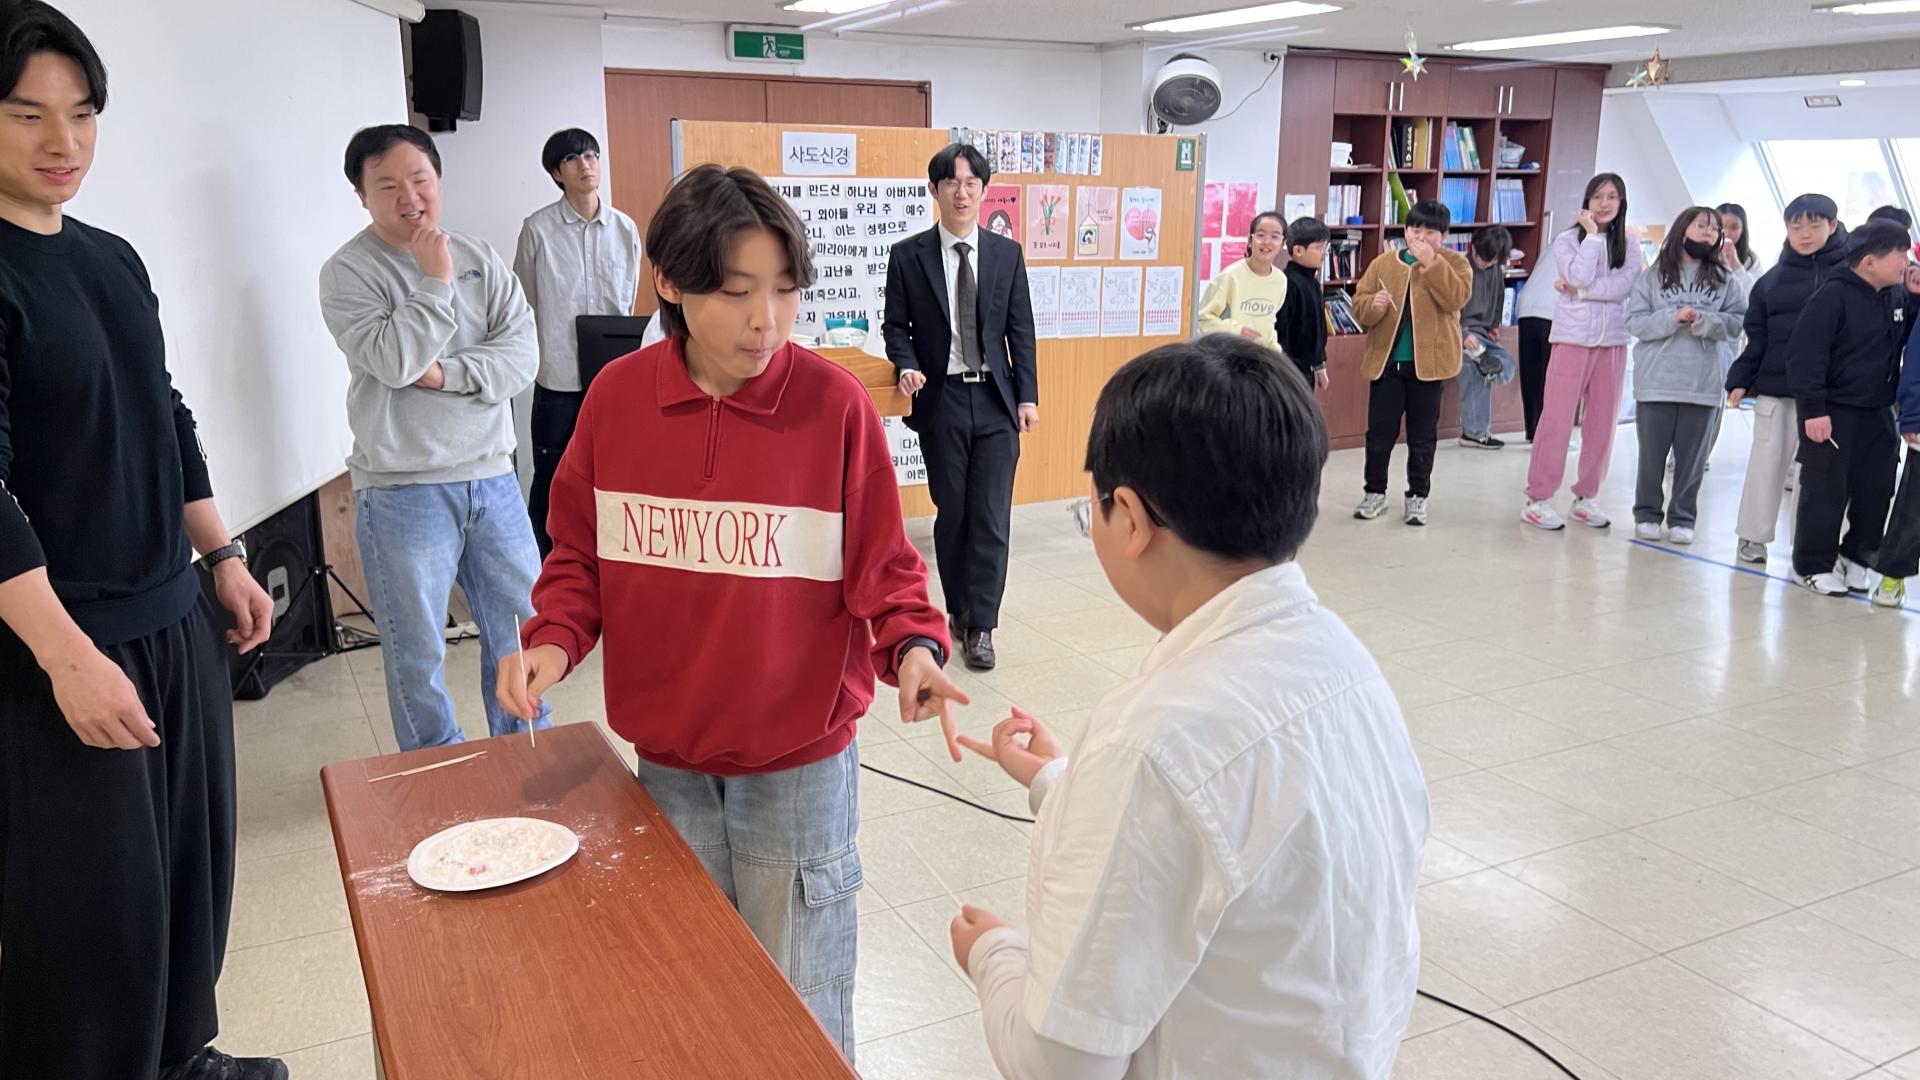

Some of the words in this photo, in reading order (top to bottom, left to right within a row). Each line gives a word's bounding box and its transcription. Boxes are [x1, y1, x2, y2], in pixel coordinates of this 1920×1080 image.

[788, 145, 849, 165] 사도신경
[809, 184, 840, 197] 만드신
[847, 185, 878, 198] 하나님
[886, 185, 927, 198] 아버지를
[802, 209, 812, 221] 그
[856, 203, 876, 215] 우리
[882, 203, 892, 215] 주
[905, 204, 926, 216] 예수
[835, 224, 856, 237] 이는
[867, 221, 908, 236] 성령으로
[817, 243, 868, 258] 마리아에게
[823, 265, 853, 277] 고난을
[867, 263, 888, 275] 받으
[1240, 301, 1275, 314] move
[806, 311, 816, 323] 자
[907, 468, 926, 480] 아멘
[621, 501, 788, 568] NEWYORK
